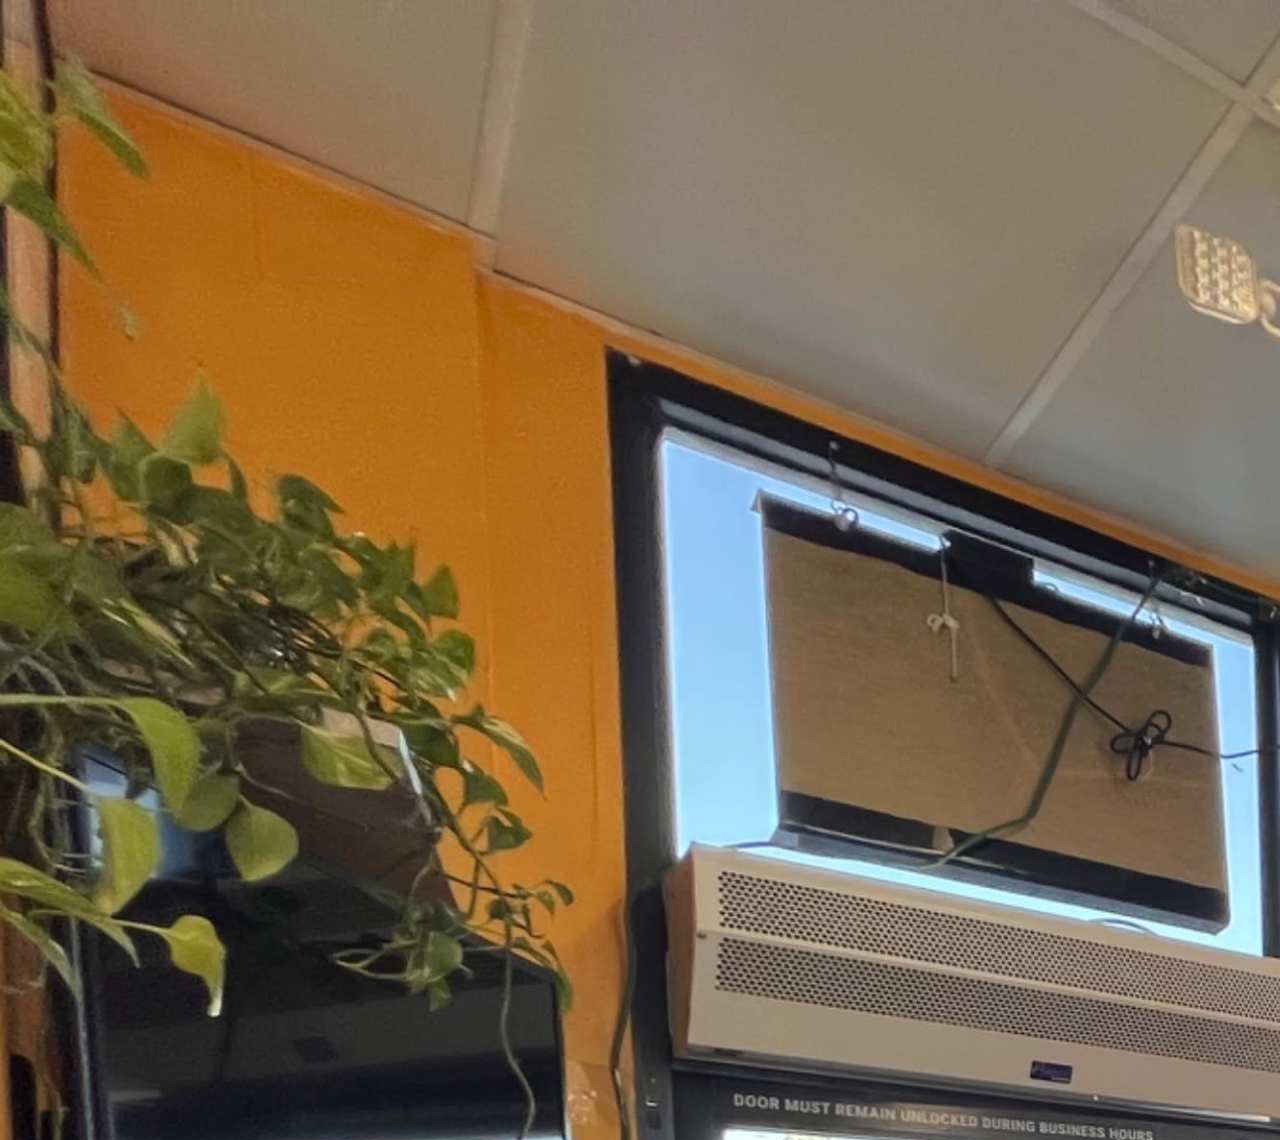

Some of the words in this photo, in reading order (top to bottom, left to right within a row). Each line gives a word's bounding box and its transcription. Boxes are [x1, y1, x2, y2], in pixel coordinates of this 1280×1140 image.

[733, 1093, 780, 1110] DOOR
[784, 1098, 830, 1114] MUST
[835, 1103, 897, 1121] REMAIN
[901, 1108, 978, 1127] UNLOCKED
[982, 1116, 1035, 1133] DURING
[1039, 1121, 1105, 1139] BUSINESS
